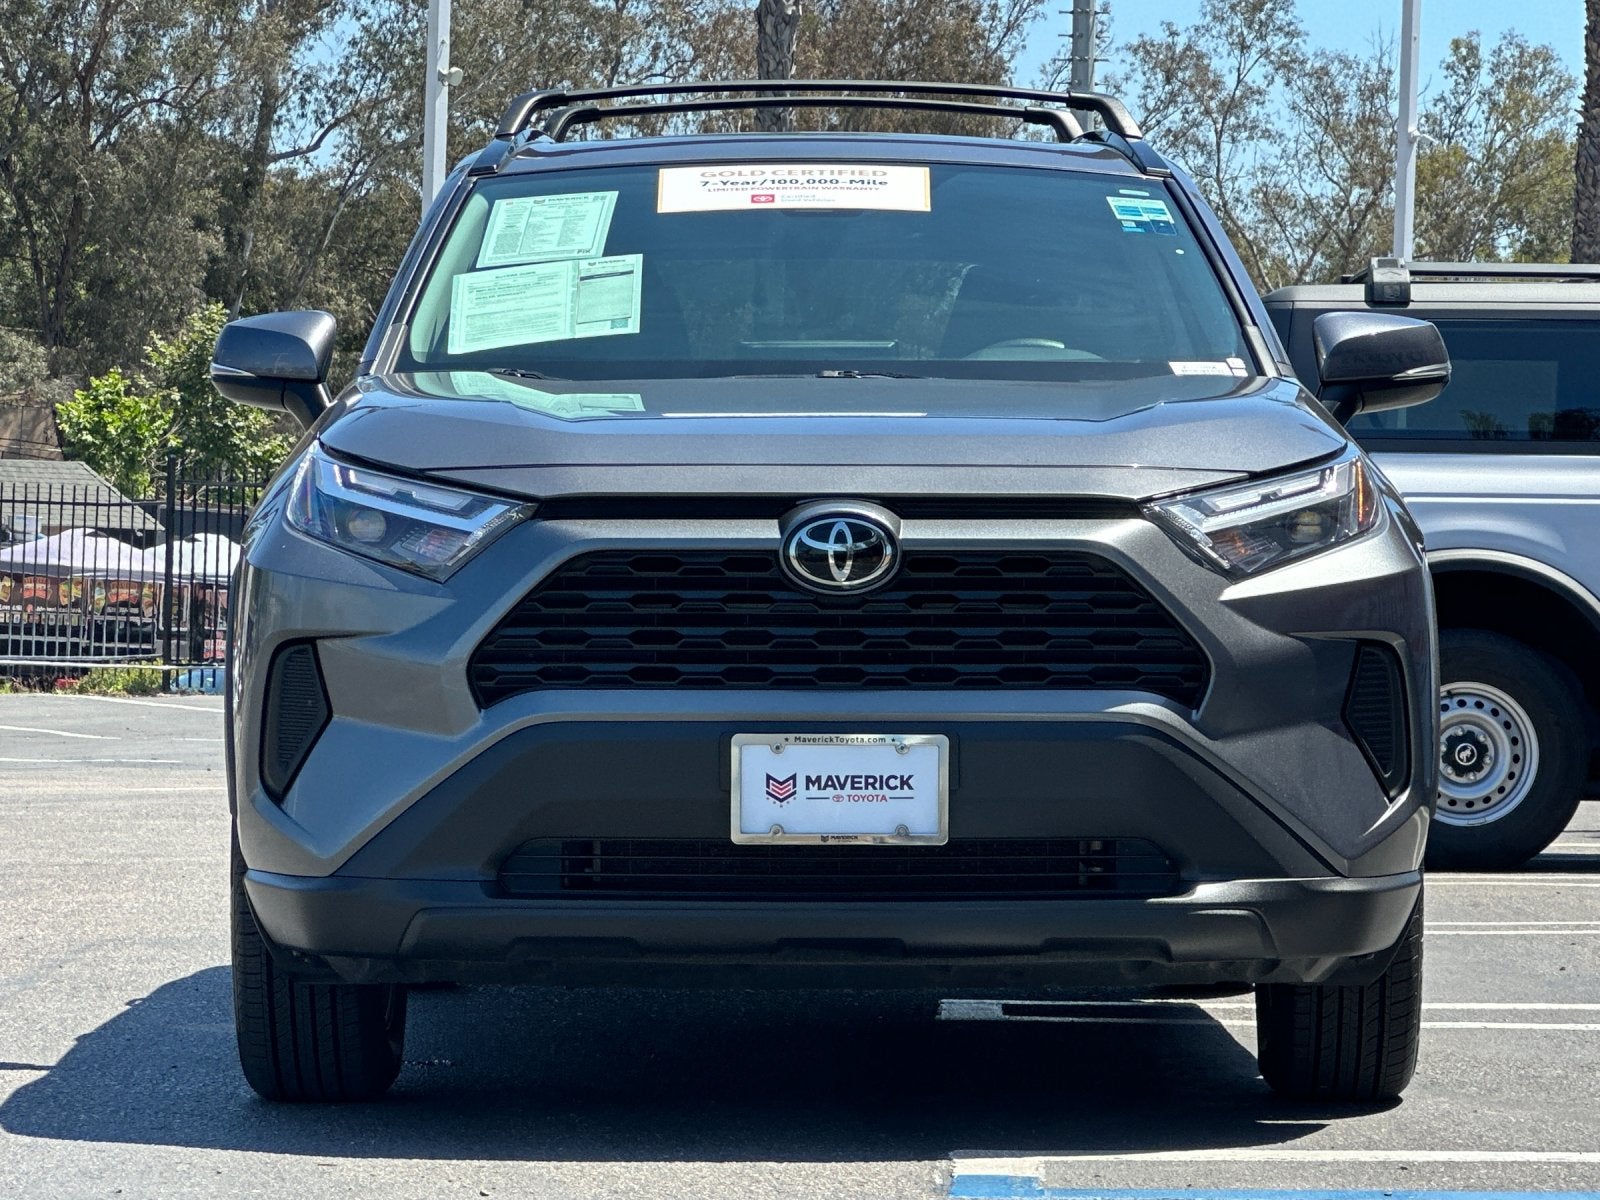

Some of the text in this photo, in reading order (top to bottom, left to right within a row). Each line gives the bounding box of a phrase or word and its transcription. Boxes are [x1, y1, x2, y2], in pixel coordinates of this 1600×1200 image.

[700, 168, 888, 178] GOLD CERTIFIED
[699, 178, 889, 187] 7-Year/100,000-Mile
[794, 736, 886, 744] MaverickToyota.com
[805, 774, 914, 791] MAVERICK
[847, 794, 888, 803] TOYOTA
